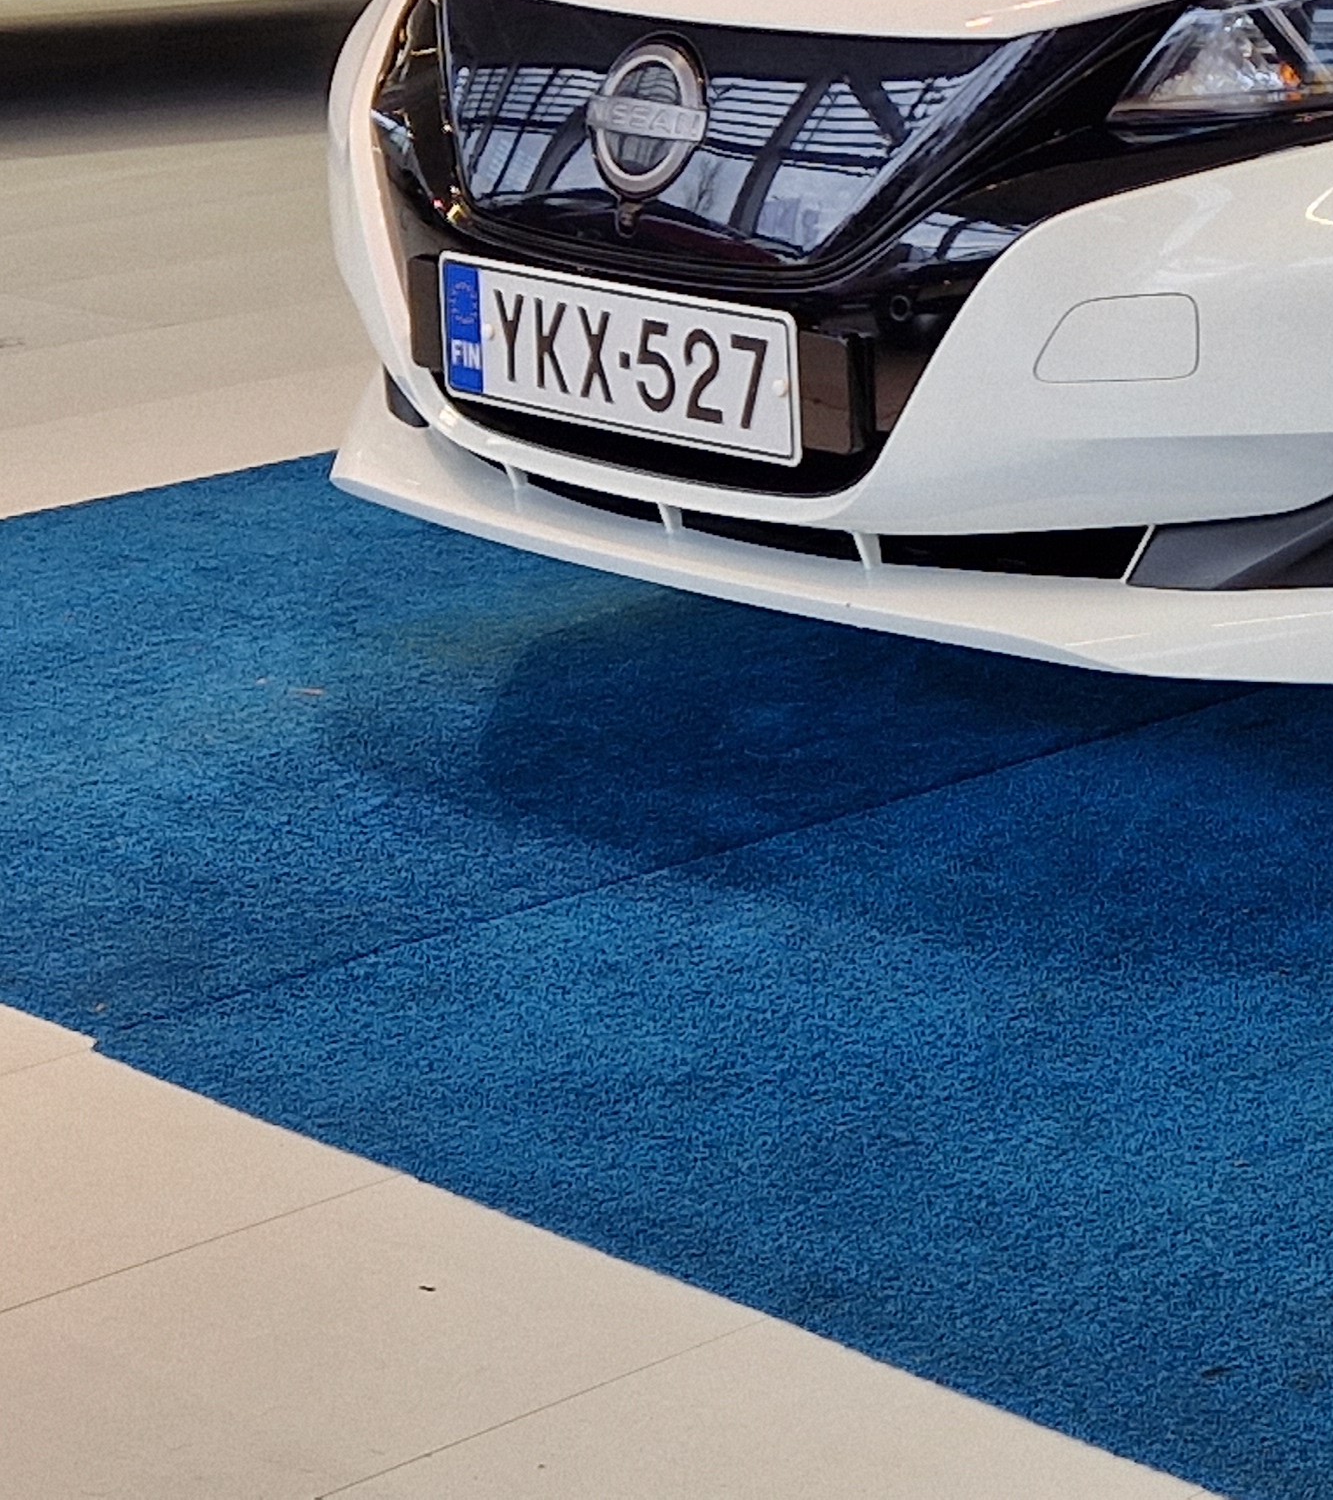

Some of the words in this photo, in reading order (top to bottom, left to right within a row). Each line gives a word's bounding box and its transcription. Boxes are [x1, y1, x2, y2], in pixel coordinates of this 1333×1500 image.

[586, 96, 701, 138] NISSAN
[451, 339, 481, 370] FIN
[493, 289, 769, 430] YKX-527
